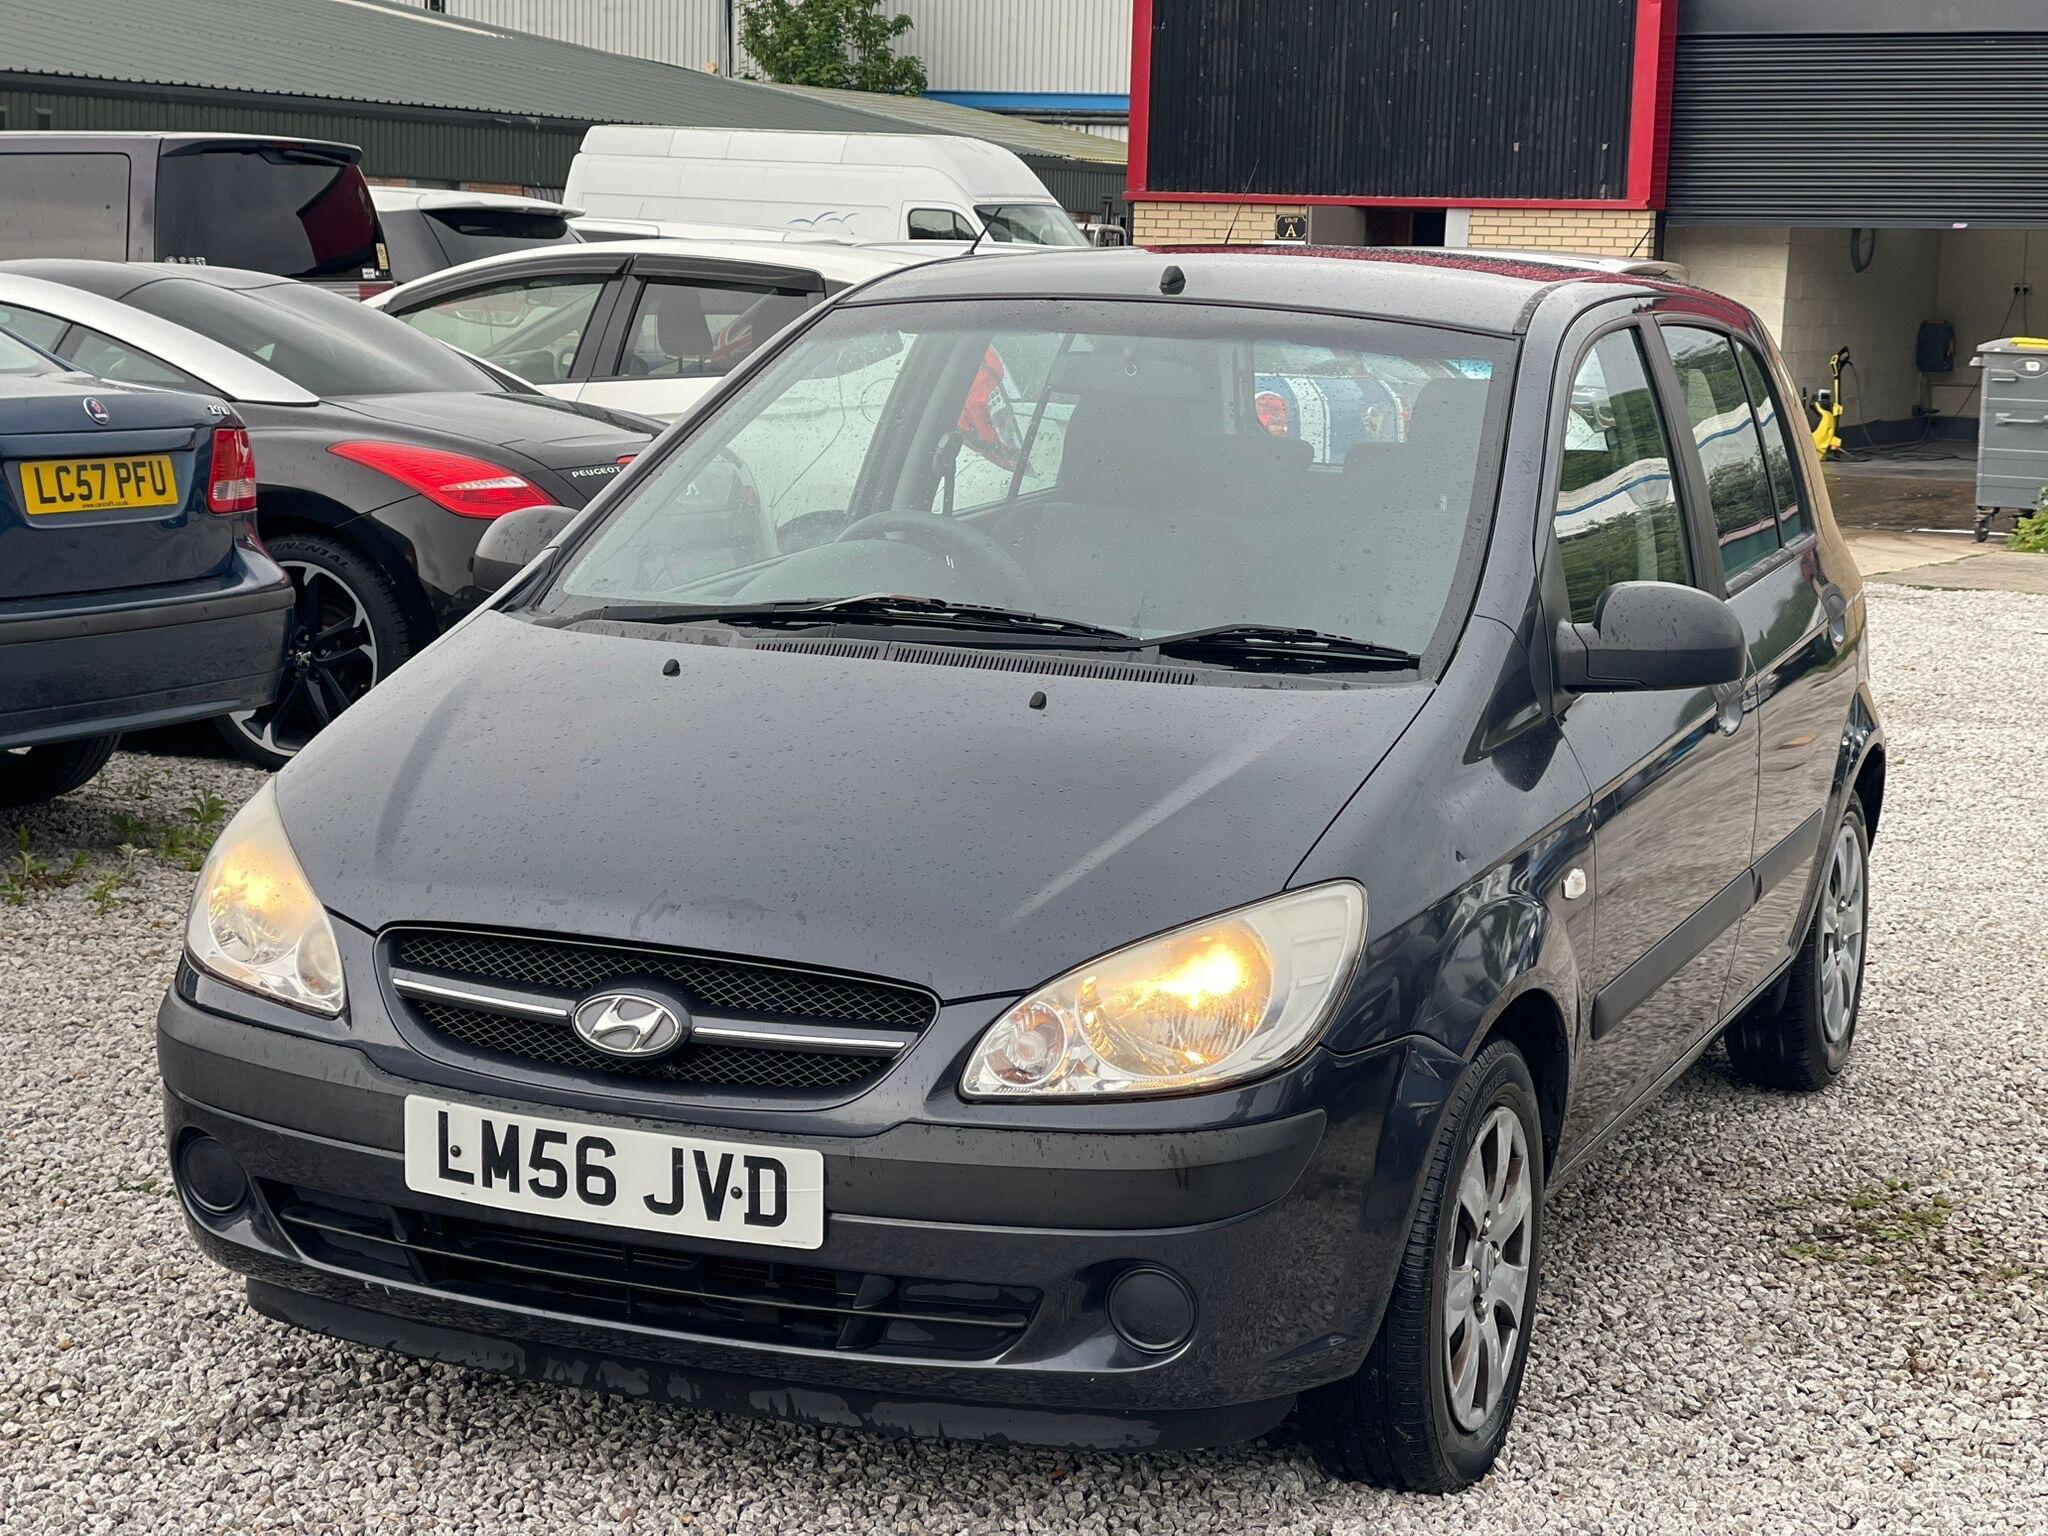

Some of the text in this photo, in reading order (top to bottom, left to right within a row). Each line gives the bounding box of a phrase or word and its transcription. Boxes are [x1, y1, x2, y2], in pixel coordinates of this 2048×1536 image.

[1285, 224, 1297, 237] A
[34, 460, 167, 504] LC57 PFU
[571, 466, 621, 478] PEUGEOT
[438, 1111, 788, 1228] LM56 JVD
